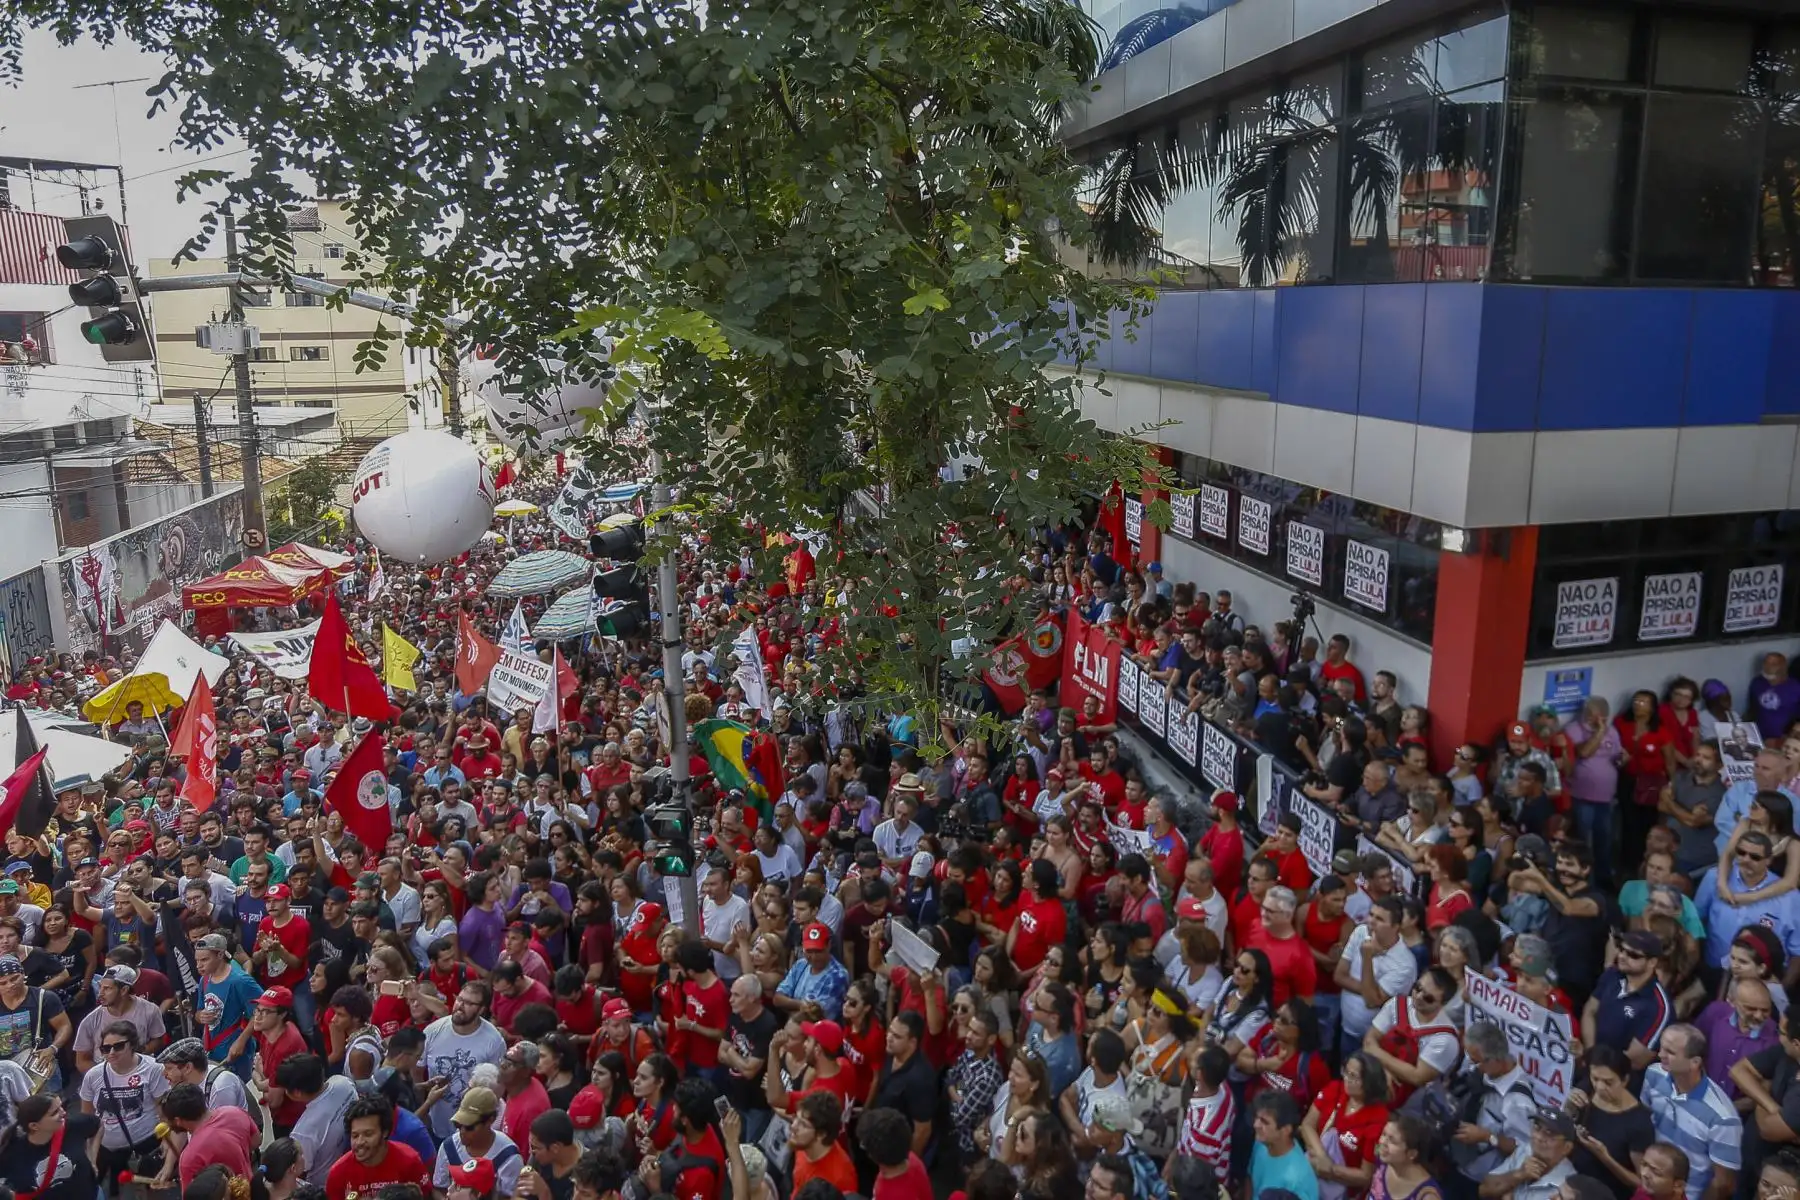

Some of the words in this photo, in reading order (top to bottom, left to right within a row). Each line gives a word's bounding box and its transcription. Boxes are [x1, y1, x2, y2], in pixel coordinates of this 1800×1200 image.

[353, 471, 383, 504] CUT
[1210, 515, 1226, 530] LULA
[1240, 526, 1248, 539] DE
[1250, 529, 1267, 546] LULA
[269, 553, 306, 561] PCO
[1289, 554, 1298, 567] DE
[1300, 557, 1320, 576] LULA
[224, 571, 265, 581] PCO
[192, 592, 226, 604] PCO
[1347, 576, 1358, 590] DE
[1360, 578, 1384, 600] LULA
[1643, 615, 1659, 628] DE
[1662, 612, 1693, 626] LULA
[1727, 606, 1742, 620] DE
[1745, 603, 1776, 618] LULA
[1557, 622, 1574, 636] DE
[1577, 618, 1610, 634] LULA
[514, 658, 548, 682] DEFESA
[1074, 641, 1108, 688] FLM
[499, 670, 508, 682] DO
[1148, 708, 1164, 727] LULA
[1178, 732, 1194, 753] LULA
[1204, 757, 1214, 773] DE
[1214, 762, 1233, 787] LULA
[1304, 840, 1331, 867] LULA
[1519, 1054, 1564, 1094] ULA
